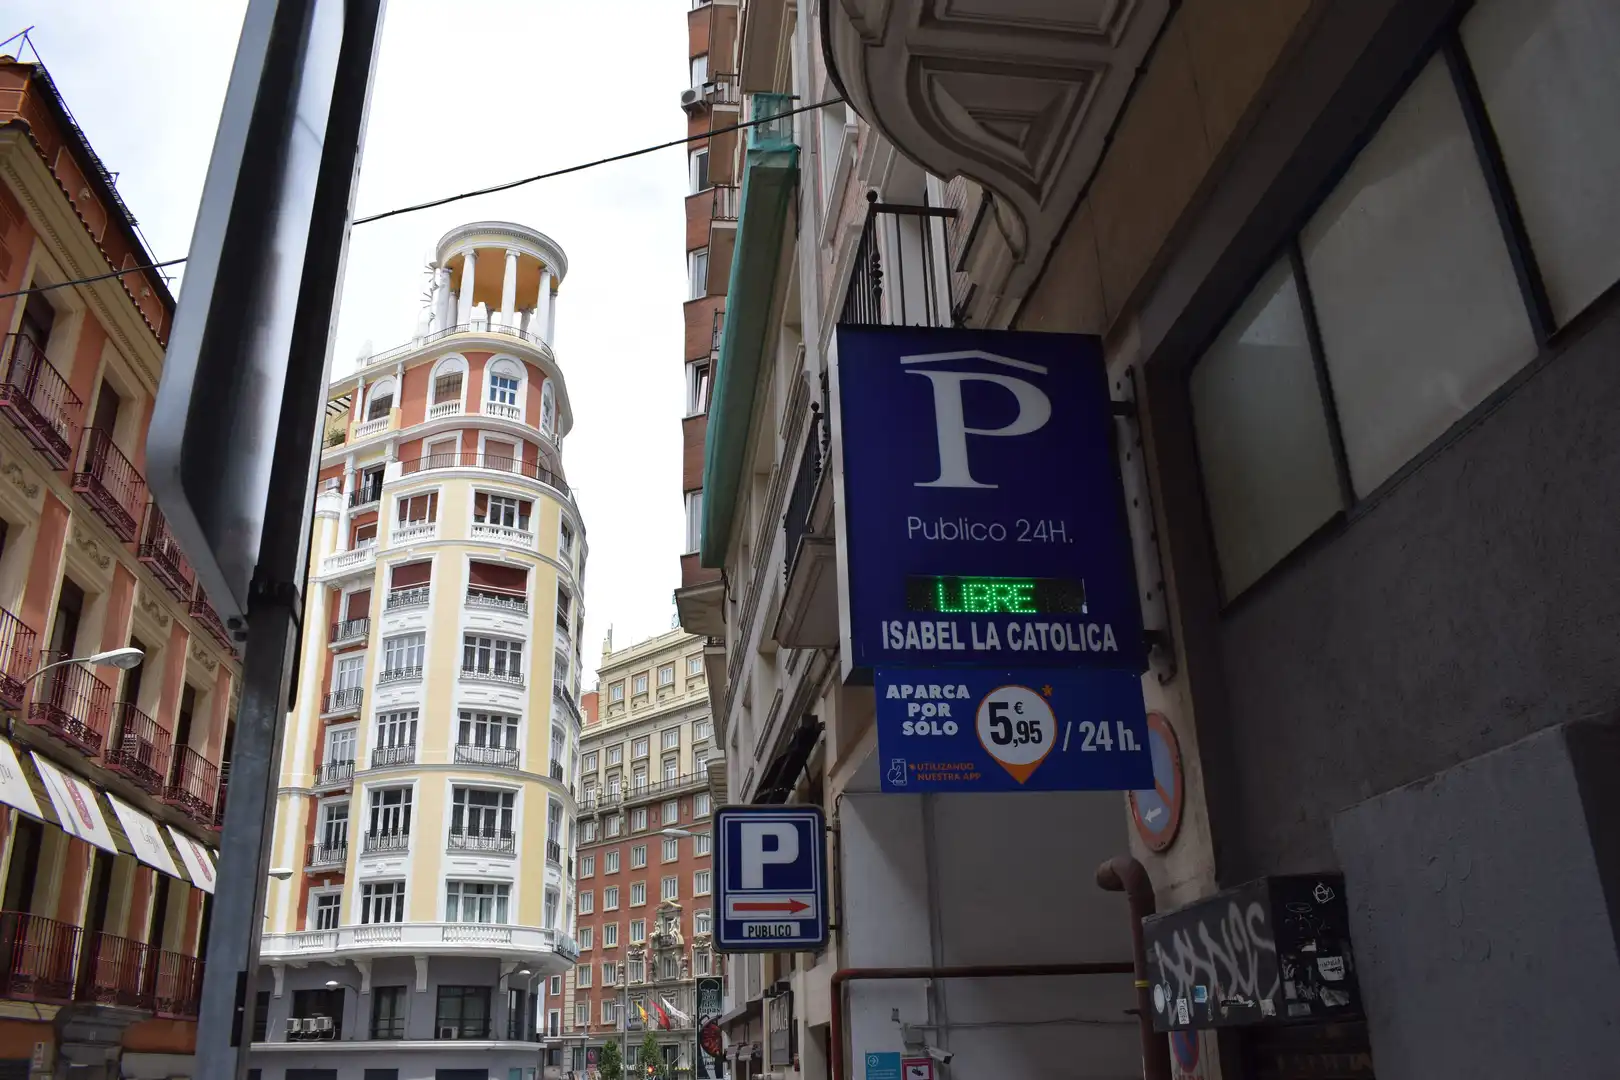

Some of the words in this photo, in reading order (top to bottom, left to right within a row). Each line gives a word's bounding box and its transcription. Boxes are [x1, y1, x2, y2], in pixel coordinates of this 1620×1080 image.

[904, 369, 1052, 488] P
[907, 516, 1007, 541] Publico
[1016, 518, 1074, 543] 24H.
[938, 583, 1037, 613] LIBRE
[882, 620, 966, 650] ISABEL
[971, 621, 1001, 651] LA
[1006, 622, 1119, 651] CATOLICA
[886, 684, 971, 699] APARCA
[907, 702, 952, 717] POR
[902, 716, 959, 736] SÓLO
[1078, 720, 1114, 752] 24
[1116, 719, 1142, 752] h.
[916, 772, 961, 781] NUESTRA
[963, 772, 982, 781] APP
[740, 822, 799, 889] P
[748, 924, 792, 938] PUBLICO
[699, 1007, 720, 1015] tapas
